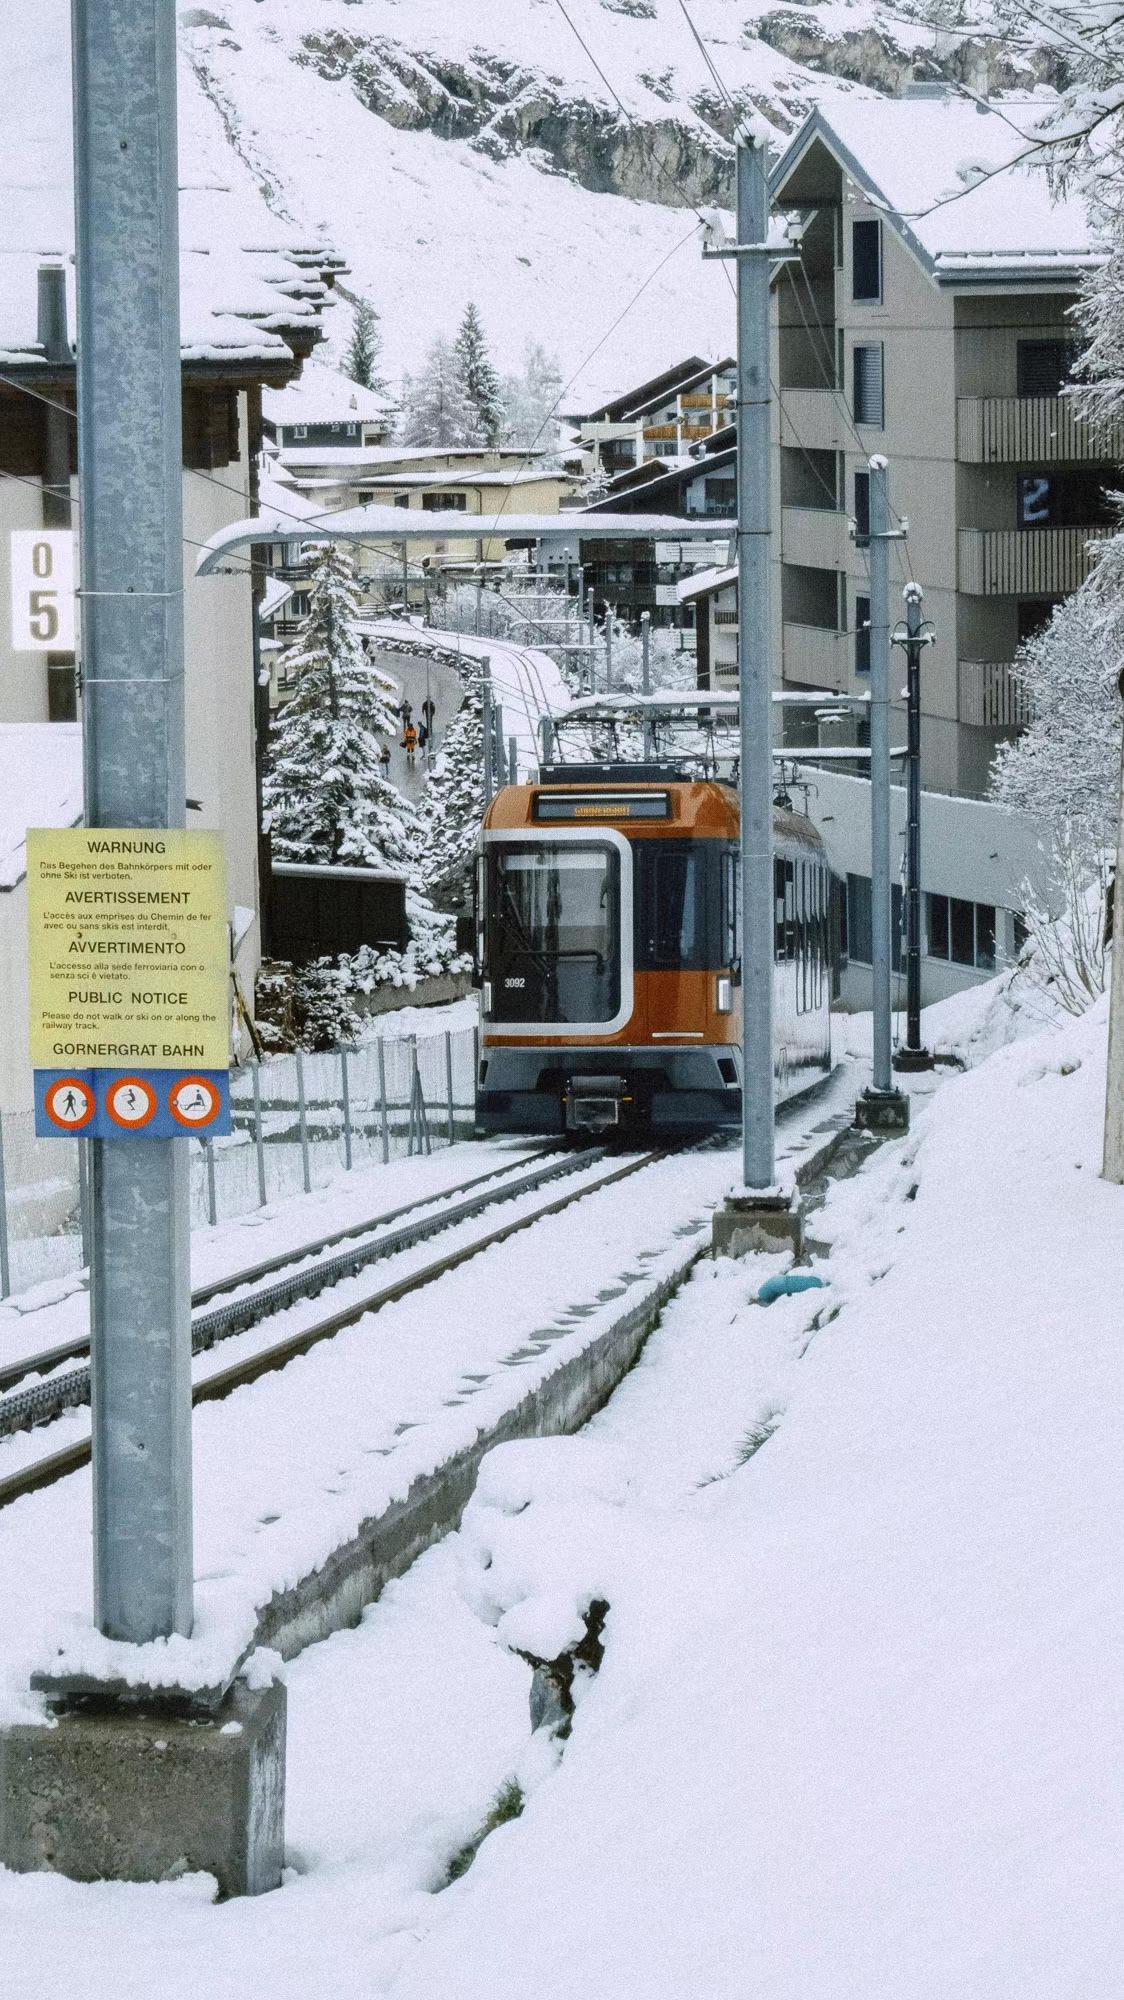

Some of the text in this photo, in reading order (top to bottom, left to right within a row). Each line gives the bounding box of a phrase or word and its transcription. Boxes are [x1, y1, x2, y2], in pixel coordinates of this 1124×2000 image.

[29, 590, 58, 641] 5
[88, 842, 166, 854] WARNUNG
[59, 862, 97, 870] Begehen
[118, 862, 173, 872] Bahnkörpers
[65, 892, 190, 904] AVERTISSEMENT
[95, 913, 135, 921] emprises
[136, 923, 170, 931] interdit.
[69, 941, 186, 954] AVVERTIMENTO
[134, 963, 178, 971] ferroviaria
[504, 978, 525, 988] 3092
[69, 991, 188, 1004] PUBLIC NOTICE
[175, 1014, 200, 1022] along
[42, 1022, 72, 1030] railway
[53, 1043, 204, 1057] GORNERGRAT BAHN
